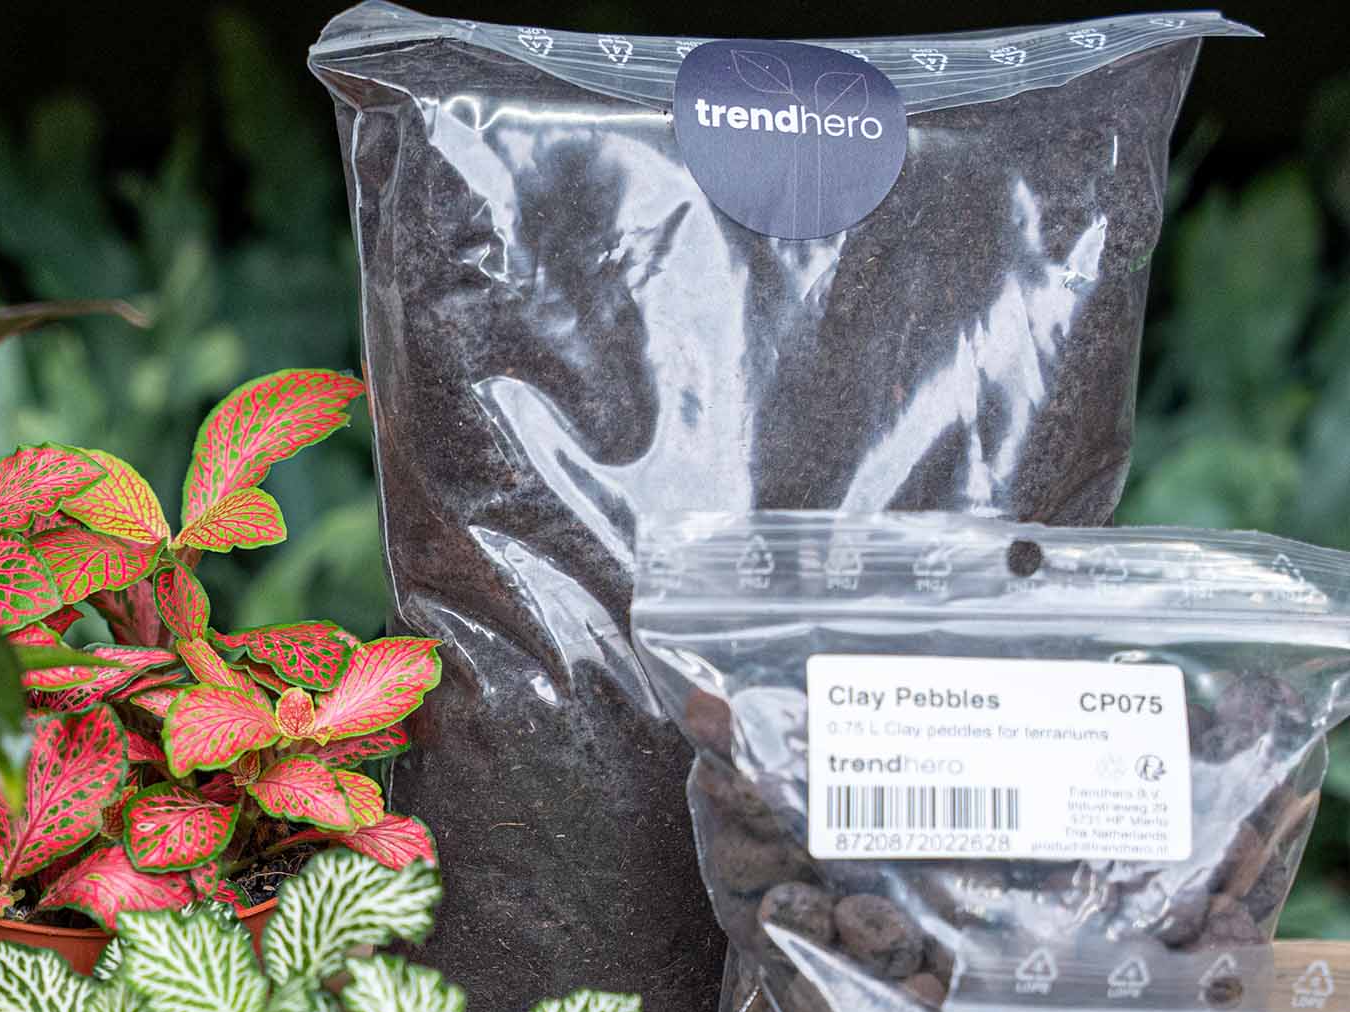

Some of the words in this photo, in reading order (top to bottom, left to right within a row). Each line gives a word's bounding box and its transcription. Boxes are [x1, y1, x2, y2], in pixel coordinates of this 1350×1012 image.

[695, 98, 883, 139] trendhero
[828, 685, 886, 711] Clay
[895, 687, 1001, 710] Pebbles
[1079, 692, 1163, 715] CP075
[998, 725, 1020, 737] for
[828, 754, 964, 776] trendhero
